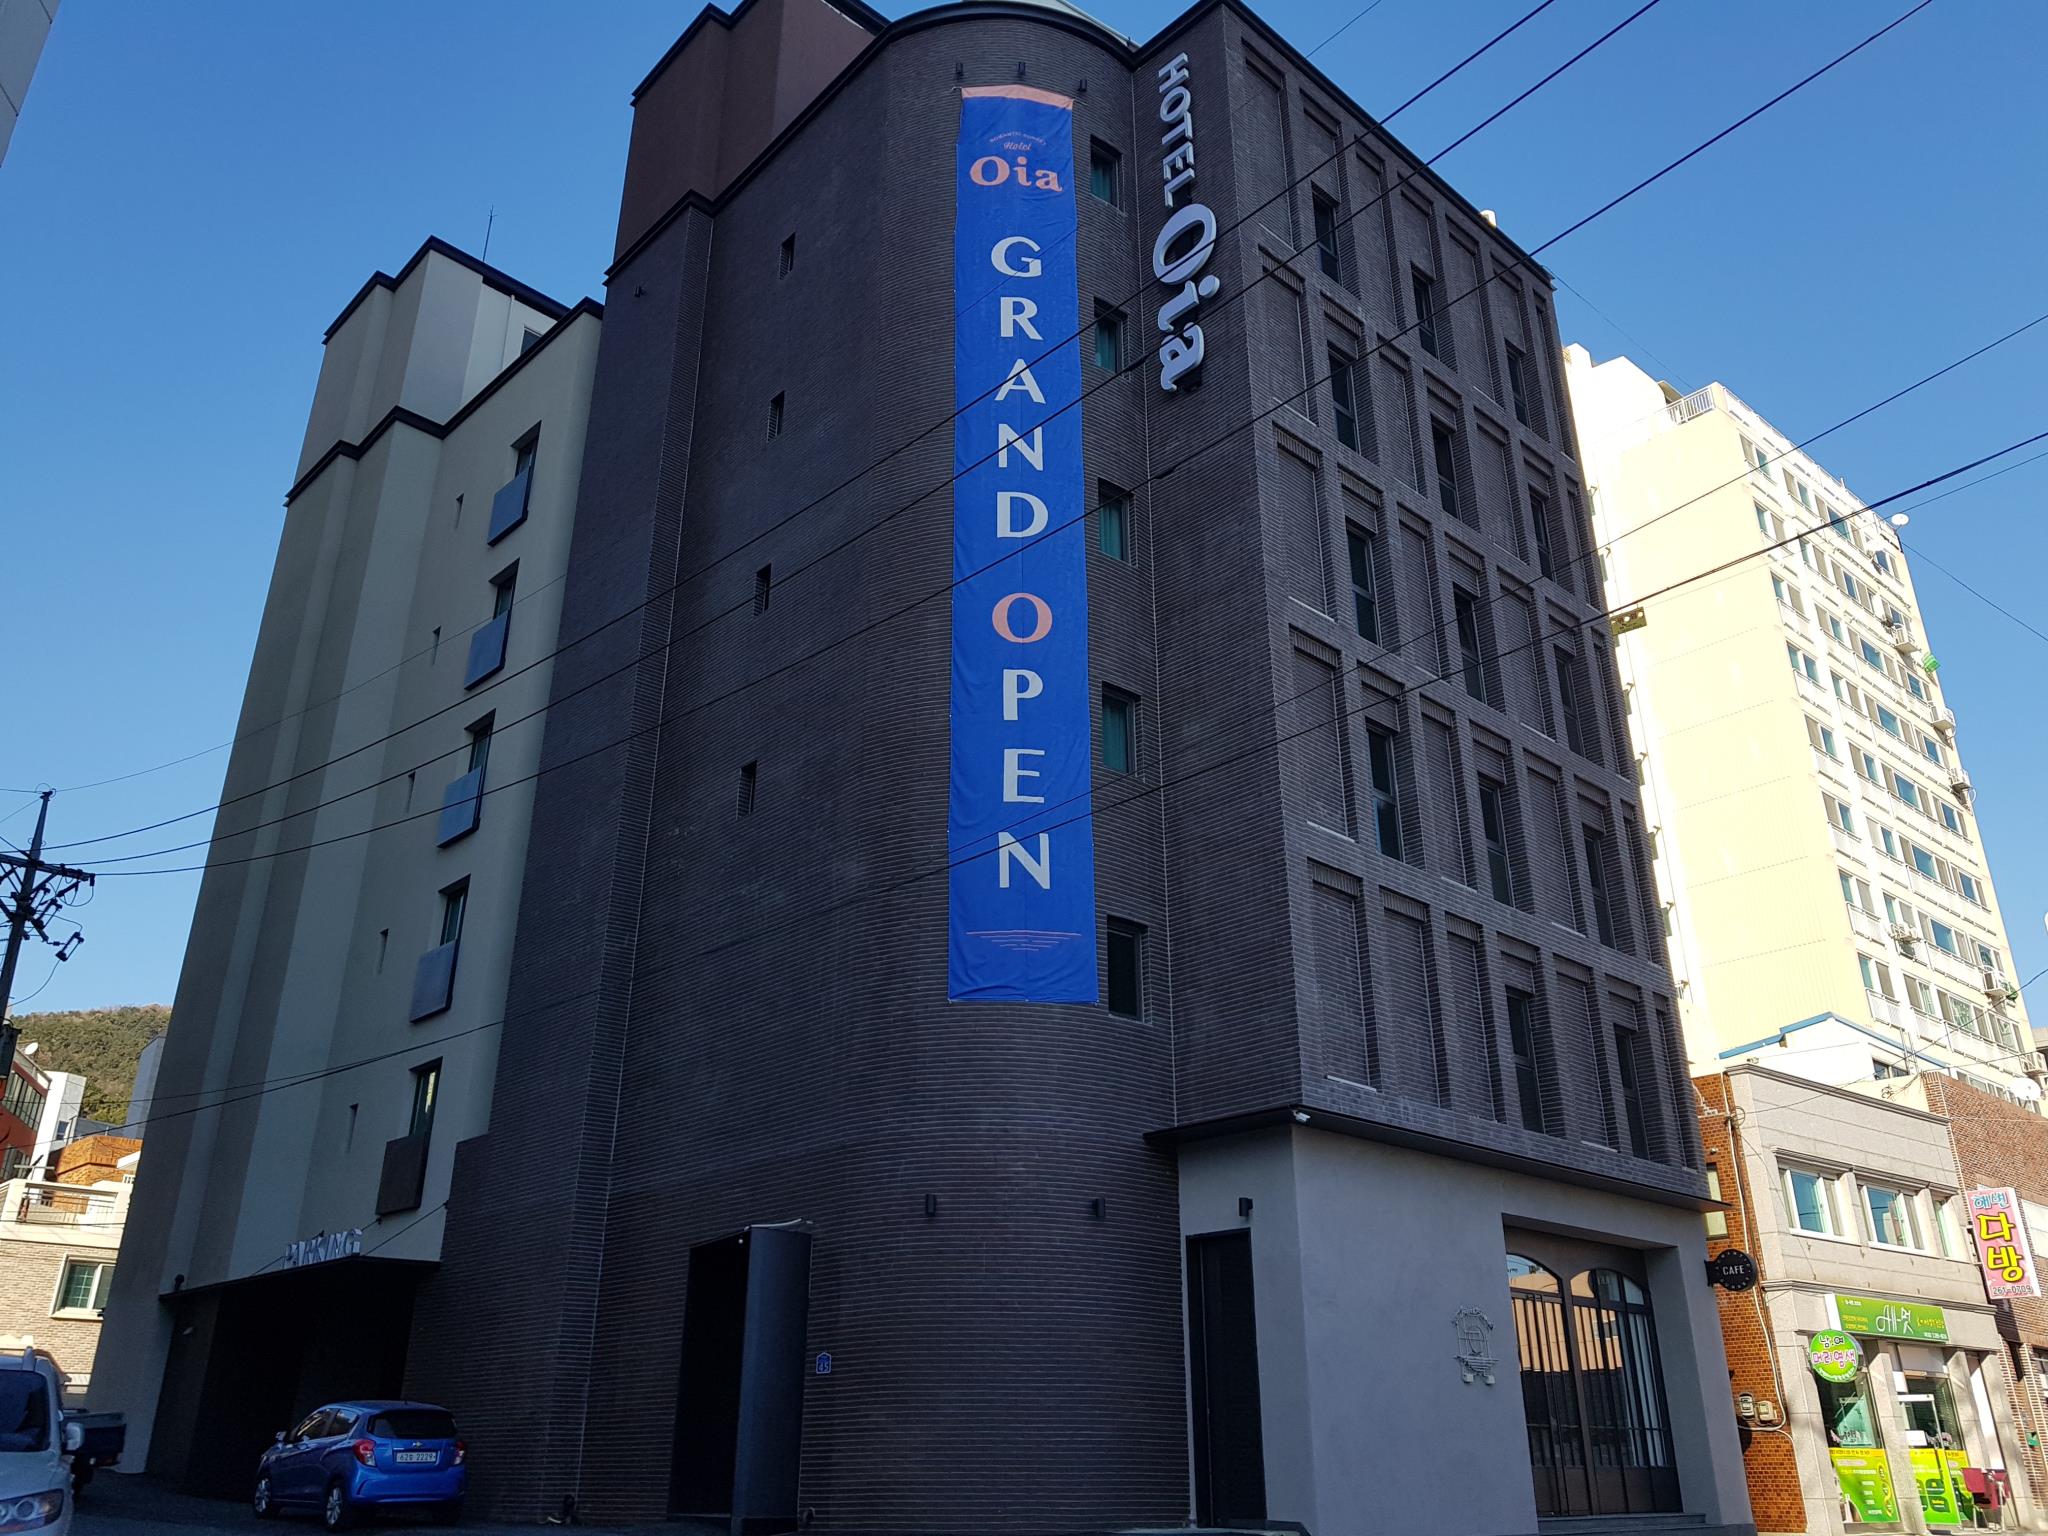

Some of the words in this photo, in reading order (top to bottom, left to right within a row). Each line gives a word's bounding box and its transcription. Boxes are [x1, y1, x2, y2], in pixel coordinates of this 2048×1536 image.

[1158, 52, 1196, 208] HOTEL
[969, 156, 1063, 192] Oia
[1152, 203, 1220, 392] Oia
[990, 235, 1049, 538] GRAND
[991, 592, 1053, 890] OPEN
[1974, 1192, 2010, 1209] 해변
[282, 1227, 363, 1269] PARKING
[1722, 1264, 1745, 1275] CAFE
[1976, 1211, 2025, 1283] 다방
